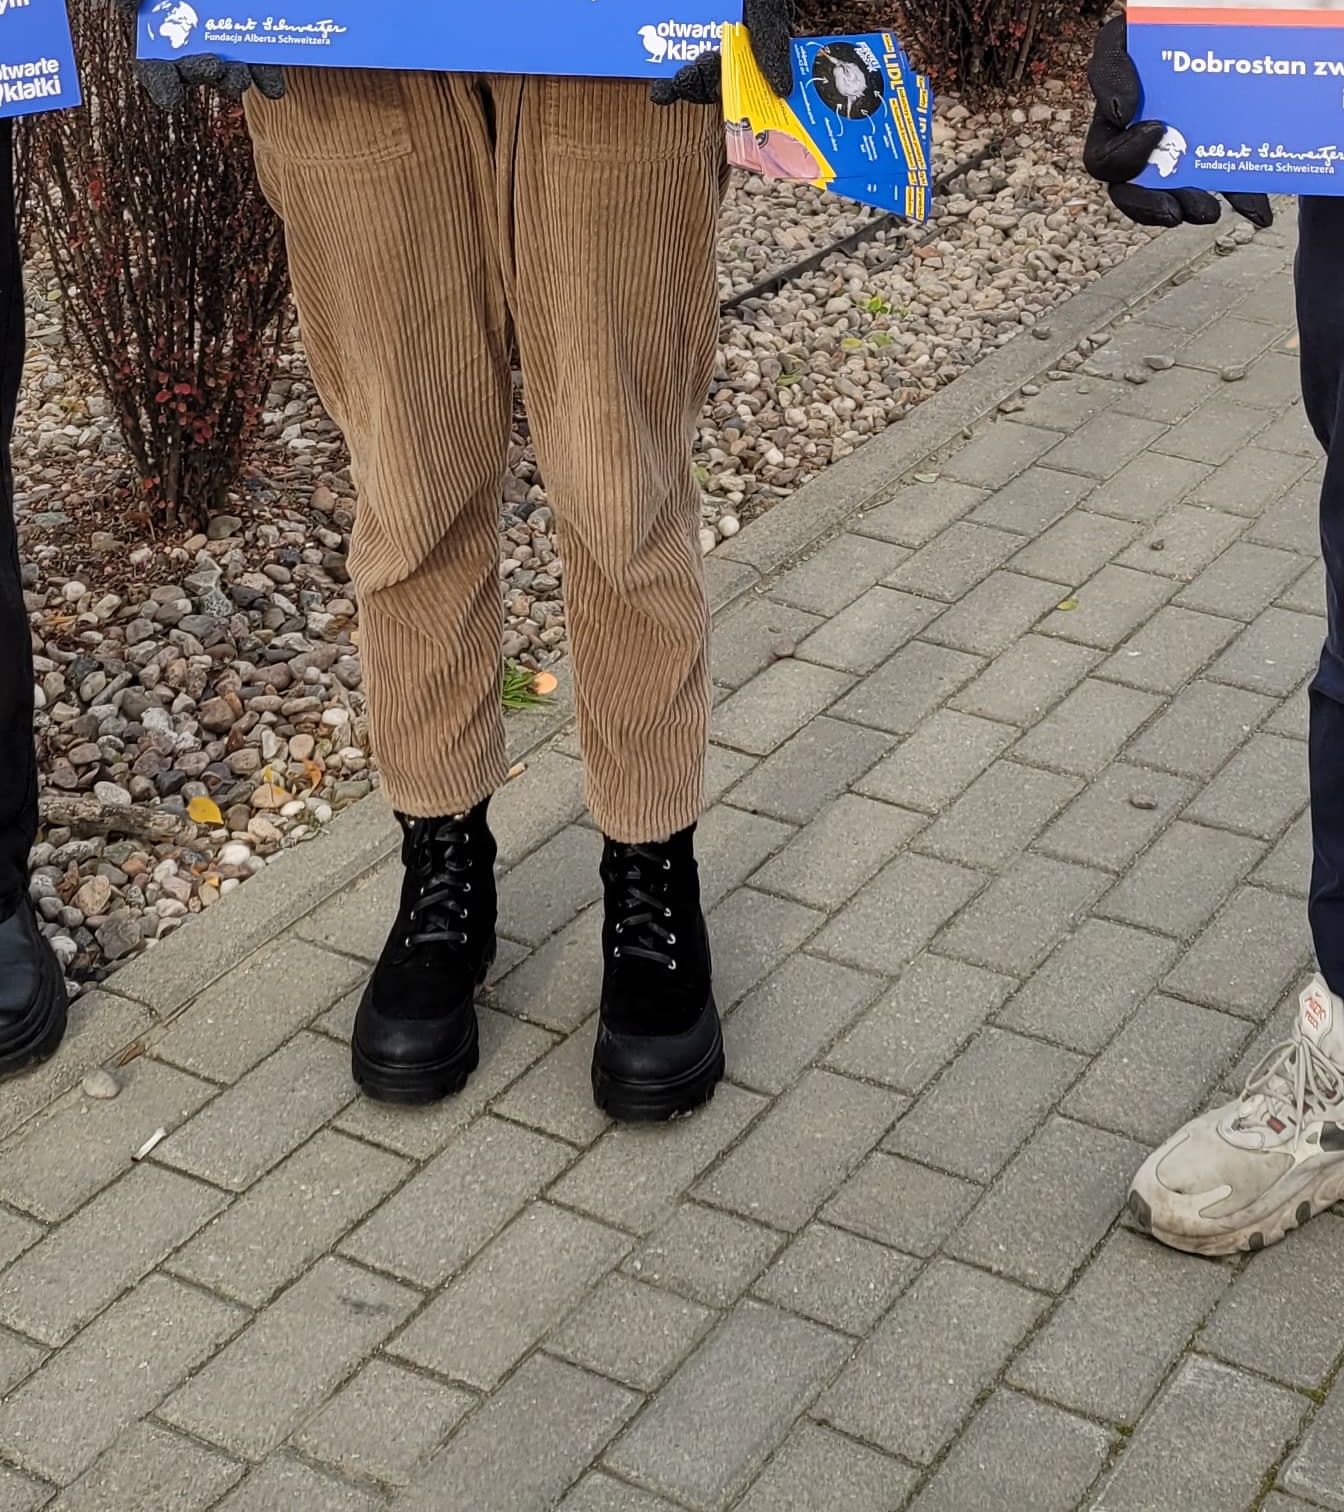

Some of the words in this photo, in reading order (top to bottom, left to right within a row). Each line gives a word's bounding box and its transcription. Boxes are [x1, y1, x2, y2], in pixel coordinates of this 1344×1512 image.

[204, 32, 243, 44] Fundacja
[243, 33, 277, 44] Alberta
[883, 54, 904, 90] LIDL
[1161, 50, 1306, 76] "Dobrostan
[4, 75, 62, 103] klatki
[1194, 159, 1236, 173] Fundacja
[1236, 160, 1274, 173] Alberta
[1275, 161, 1335, 174] Schweitzera
